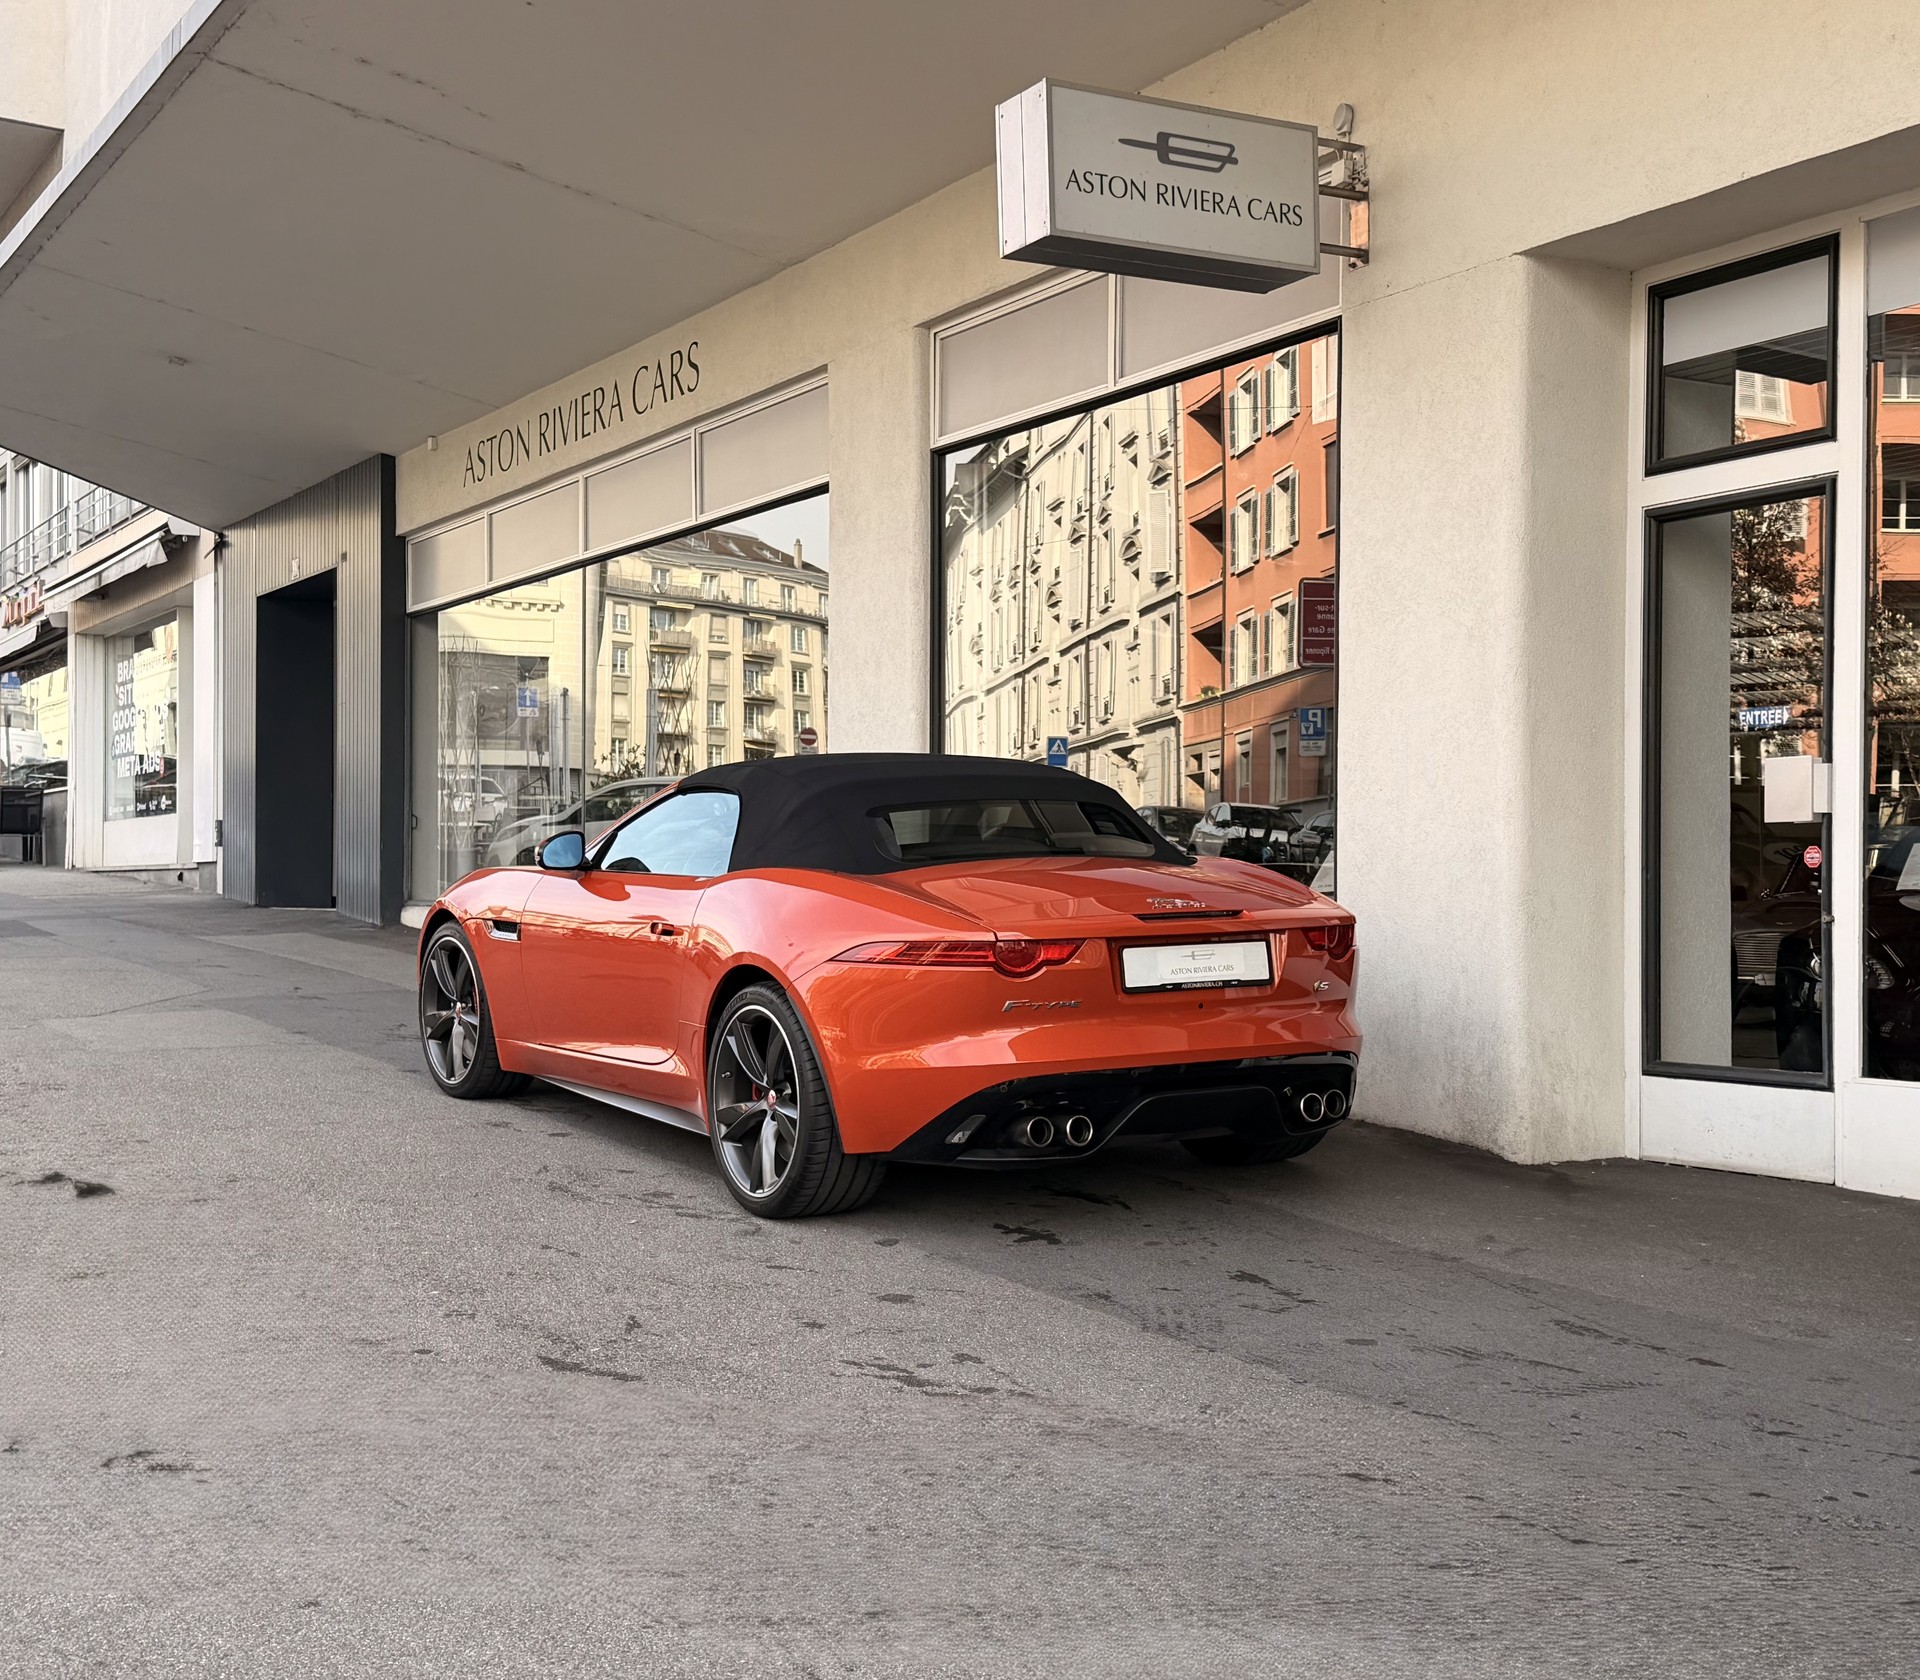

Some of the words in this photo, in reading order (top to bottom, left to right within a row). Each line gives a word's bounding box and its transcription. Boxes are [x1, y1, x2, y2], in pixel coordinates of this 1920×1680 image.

[1065, 168, 1146, 202] ASTON
[1156, 182, 1241, 218] RIVIERA
[1247, 198, 1303, 227] CARS
[463, 419, 530, 488] ASTON
[538, 378, 624, 457] RIVIERA
[632, 341, 700, 415] CARS
[1739, 709, 1782, 725] ENTREE
[117, 754, 141, 779] META
[142, 750, 161, 775] ADS
[1170, 967, 1193, 976] ASTON
[1193, 965, 1217, 974] RIVIERA
[1217, 964, 1235, 973] CARS
[1181, 981, 1223, 989] ASTONRIVIERA.CH
[1001, 999, 1082, 1012] F-TYPE
